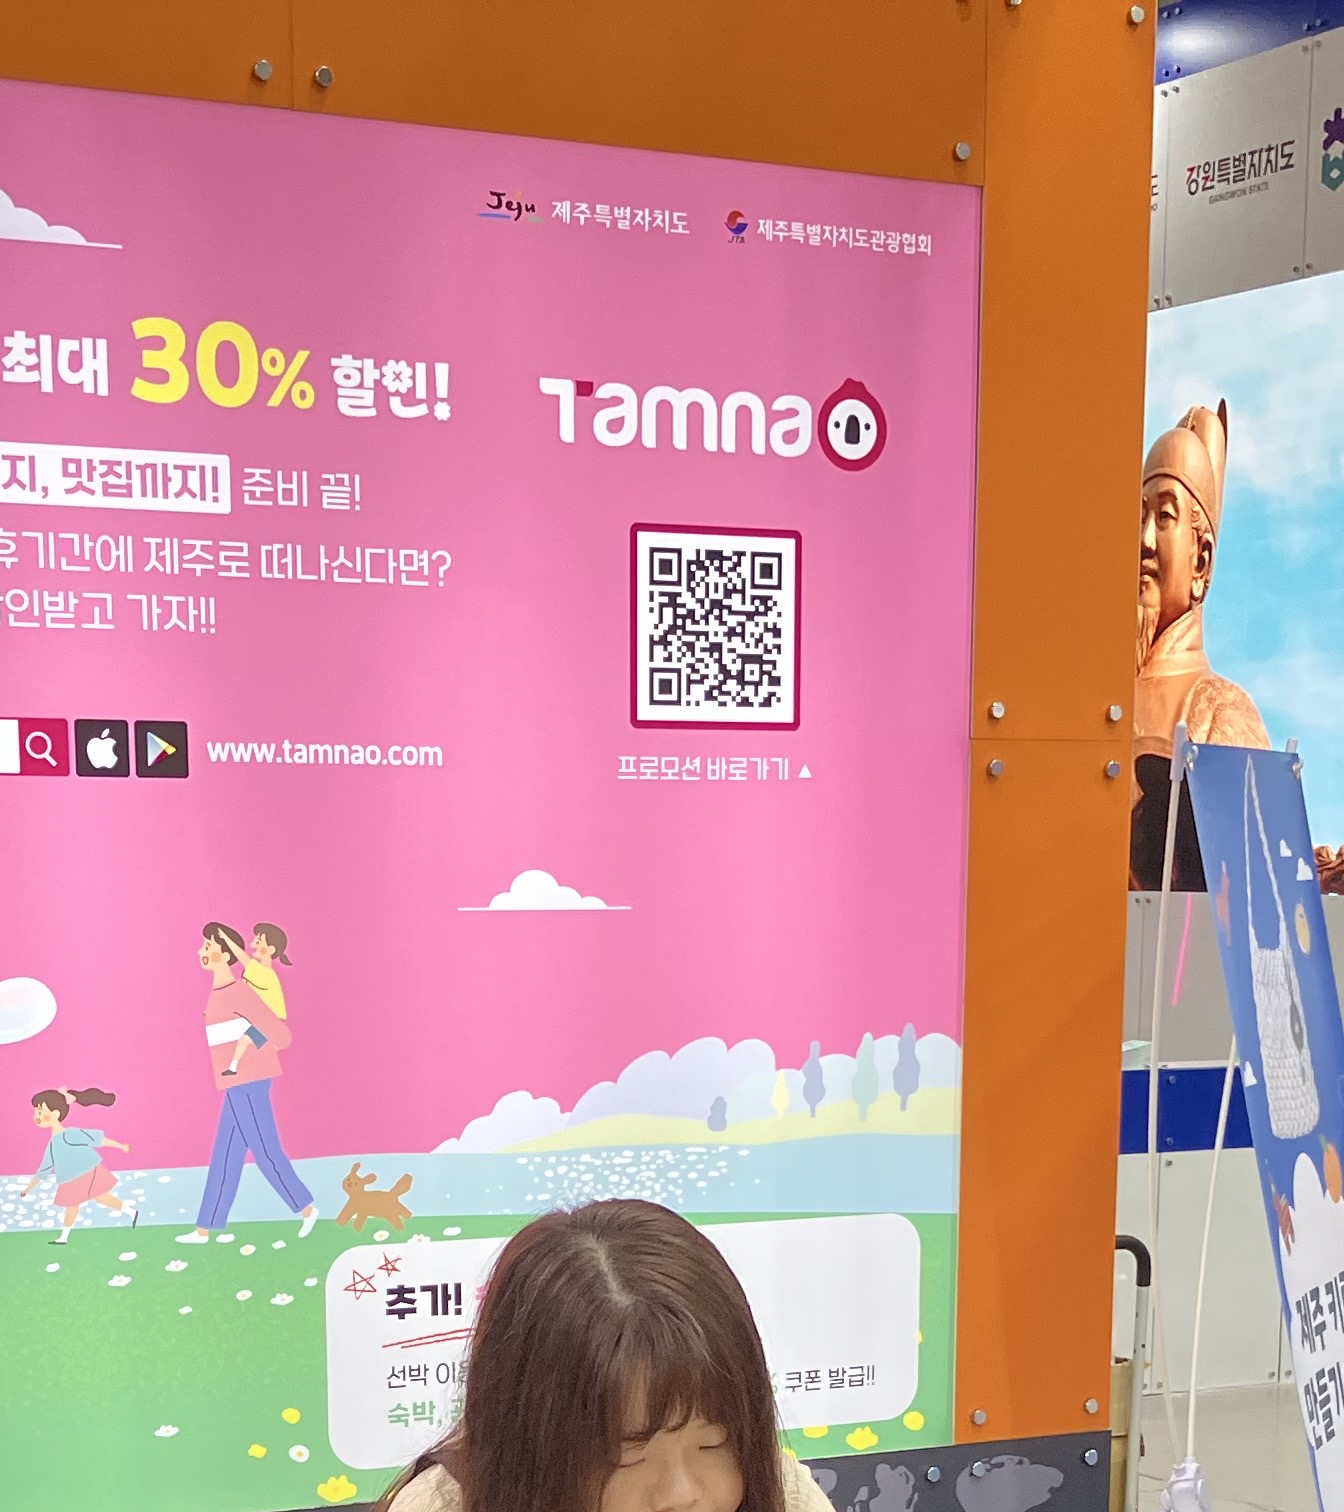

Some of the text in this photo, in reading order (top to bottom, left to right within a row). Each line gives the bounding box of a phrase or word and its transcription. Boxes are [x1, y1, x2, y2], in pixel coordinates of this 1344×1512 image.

[1186, 139, 1296, 196] 강원특별자치도
[486, 190, 536, 222] Jeju
[552, 200, 690, 234] 제주특별자치도
[756, 218, 932, 256] 제주특별자치도관광협회
[1, 329, 109, 397] 최대
[130, 317, 315, 409] 30%
[330, 354, 451, 421] 할인!
[61, 457, 220, 501] 맛집까지!
[241, 468, 309, 508] 준비
[321, 472, 361, 511] 끝!
[143, 537, 250, 579] 제주로
[260, 543, 453, 587] 떠나신다면?
[126, 593, 216, 635] 가자!!
[207, 738, 443, 768] www.tamnao.com
[618, 756, 789, 781] 프로모션 바로가기
[386, 1282, 462, 1319] 추가!
[1296, 1286, 1326, 1354] 제주
[387, 1363, 429, 1389] 선박
[785, 1369, 821, 1392] 쿠폰
[828, 1365, 875, 1389] 발급!!
[388, 1400, 442, 1428] 숙박,
